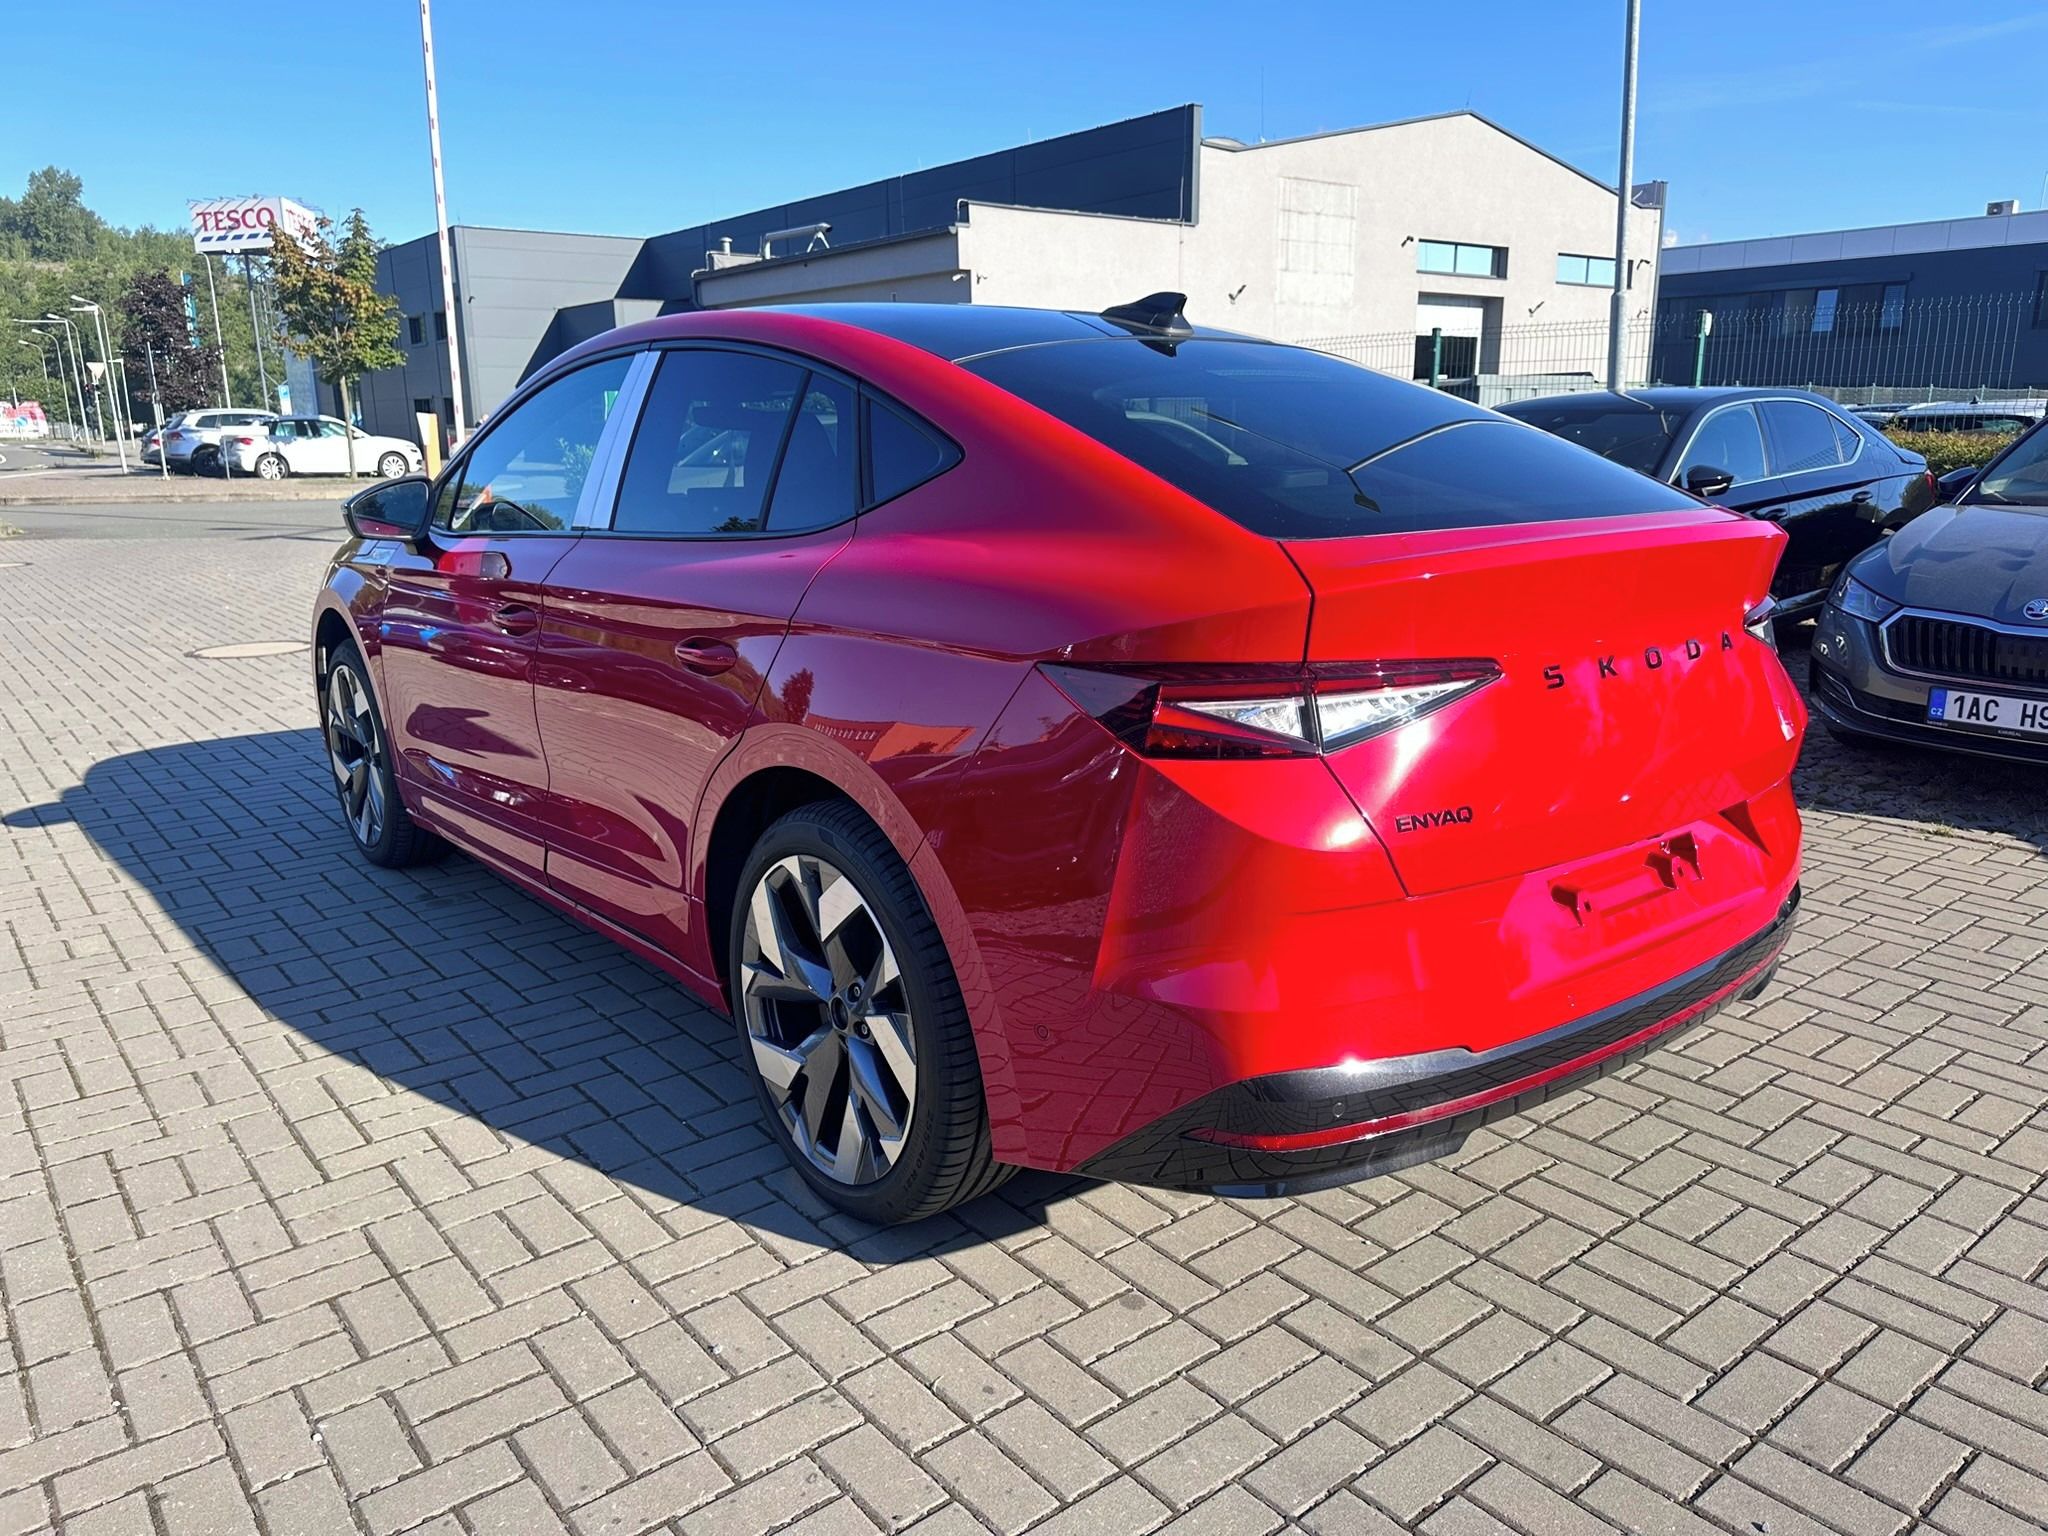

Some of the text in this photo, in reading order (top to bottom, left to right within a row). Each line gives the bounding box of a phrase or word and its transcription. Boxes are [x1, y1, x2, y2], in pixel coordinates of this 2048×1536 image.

[196, 206, 275, 232] TESCO
[1543, 631, 1733, 689] SKODA
[1930, 707, 1943, 716] CZ
[1953, 695, 2000, 723] 1AC
[1395, 806, 1473, 833] ENYAQ
